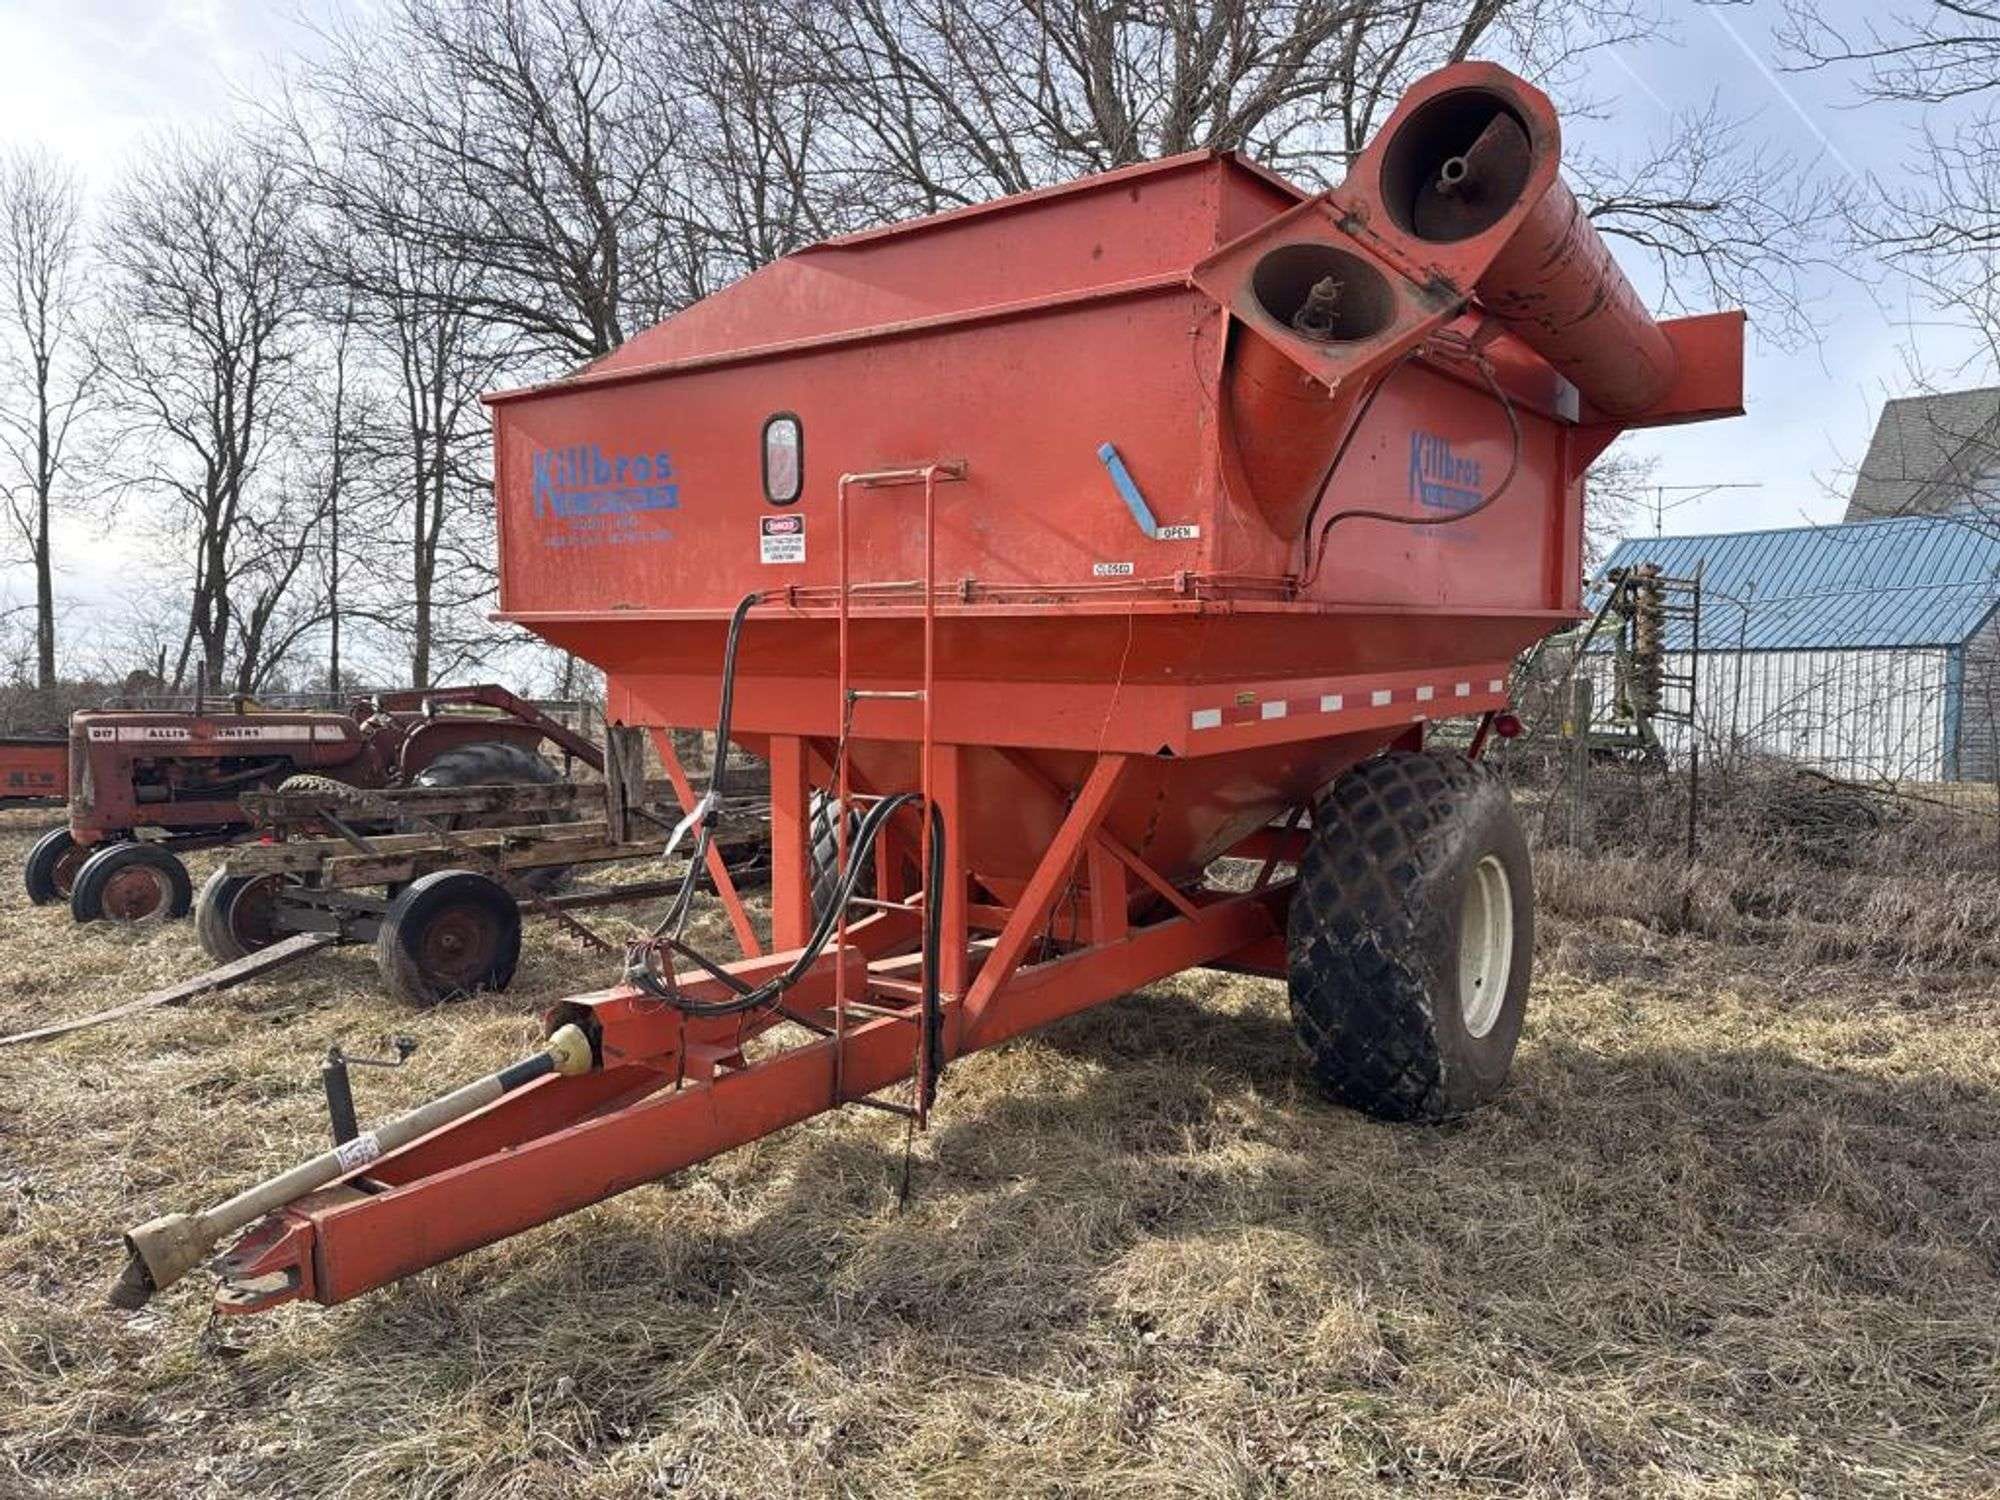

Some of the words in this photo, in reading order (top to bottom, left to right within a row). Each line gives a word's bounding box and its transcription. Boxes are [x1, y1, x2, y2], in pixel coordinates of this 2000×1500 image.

[1409, 430, 1480, 502] Killbros
[533, 444, 675, 520] Killbros
[1163, 528, 1191, 538] OPEN
[1095, 564, 1130, 573] CLOSED
[93, 730, 112, 738] D17
